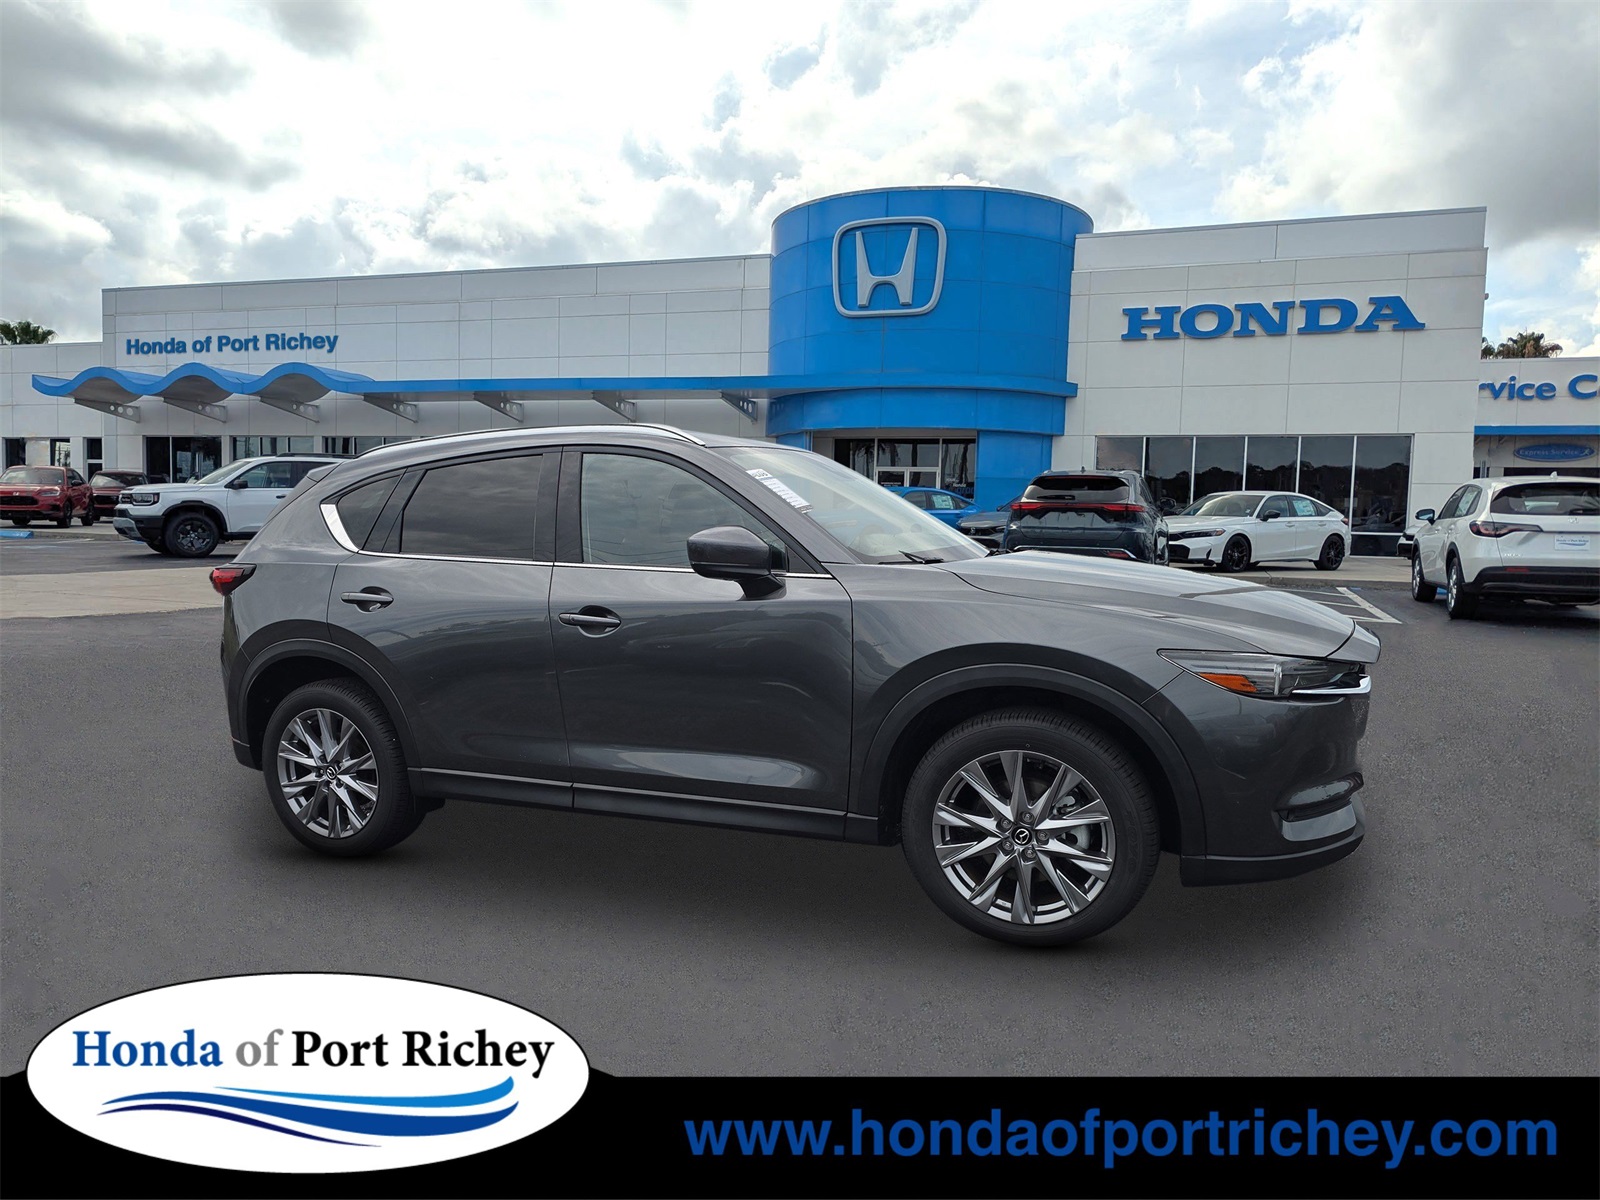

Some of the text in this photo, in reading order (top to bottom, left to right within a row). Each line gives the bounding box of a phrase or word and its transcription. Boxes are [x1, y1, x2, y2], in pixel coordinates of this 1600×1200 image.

[1120, 295, 1426, 341] HONDA
[126, 332, 339, 355] Honda of Port Richey
